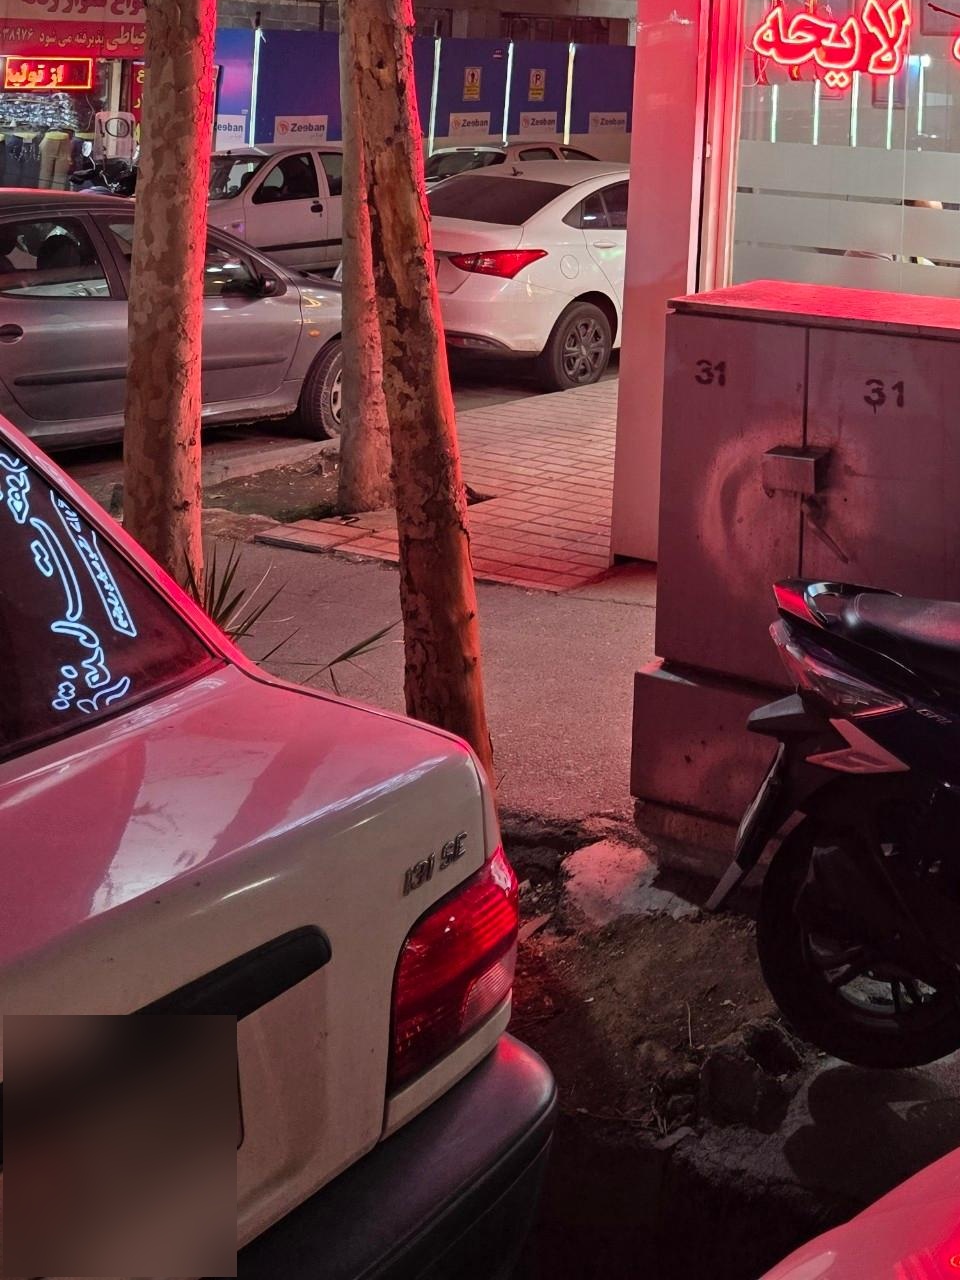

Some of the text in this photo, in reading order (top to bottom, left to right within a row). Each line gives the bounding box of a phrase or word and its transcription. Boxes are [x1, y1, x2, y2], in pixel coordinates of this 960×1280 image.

[215, 122, 244, 133] eeban
[290, 122, 326, 133] Zeeban
[694, 359, 727, 387] 31
[863, 378, 906, 409] 31
